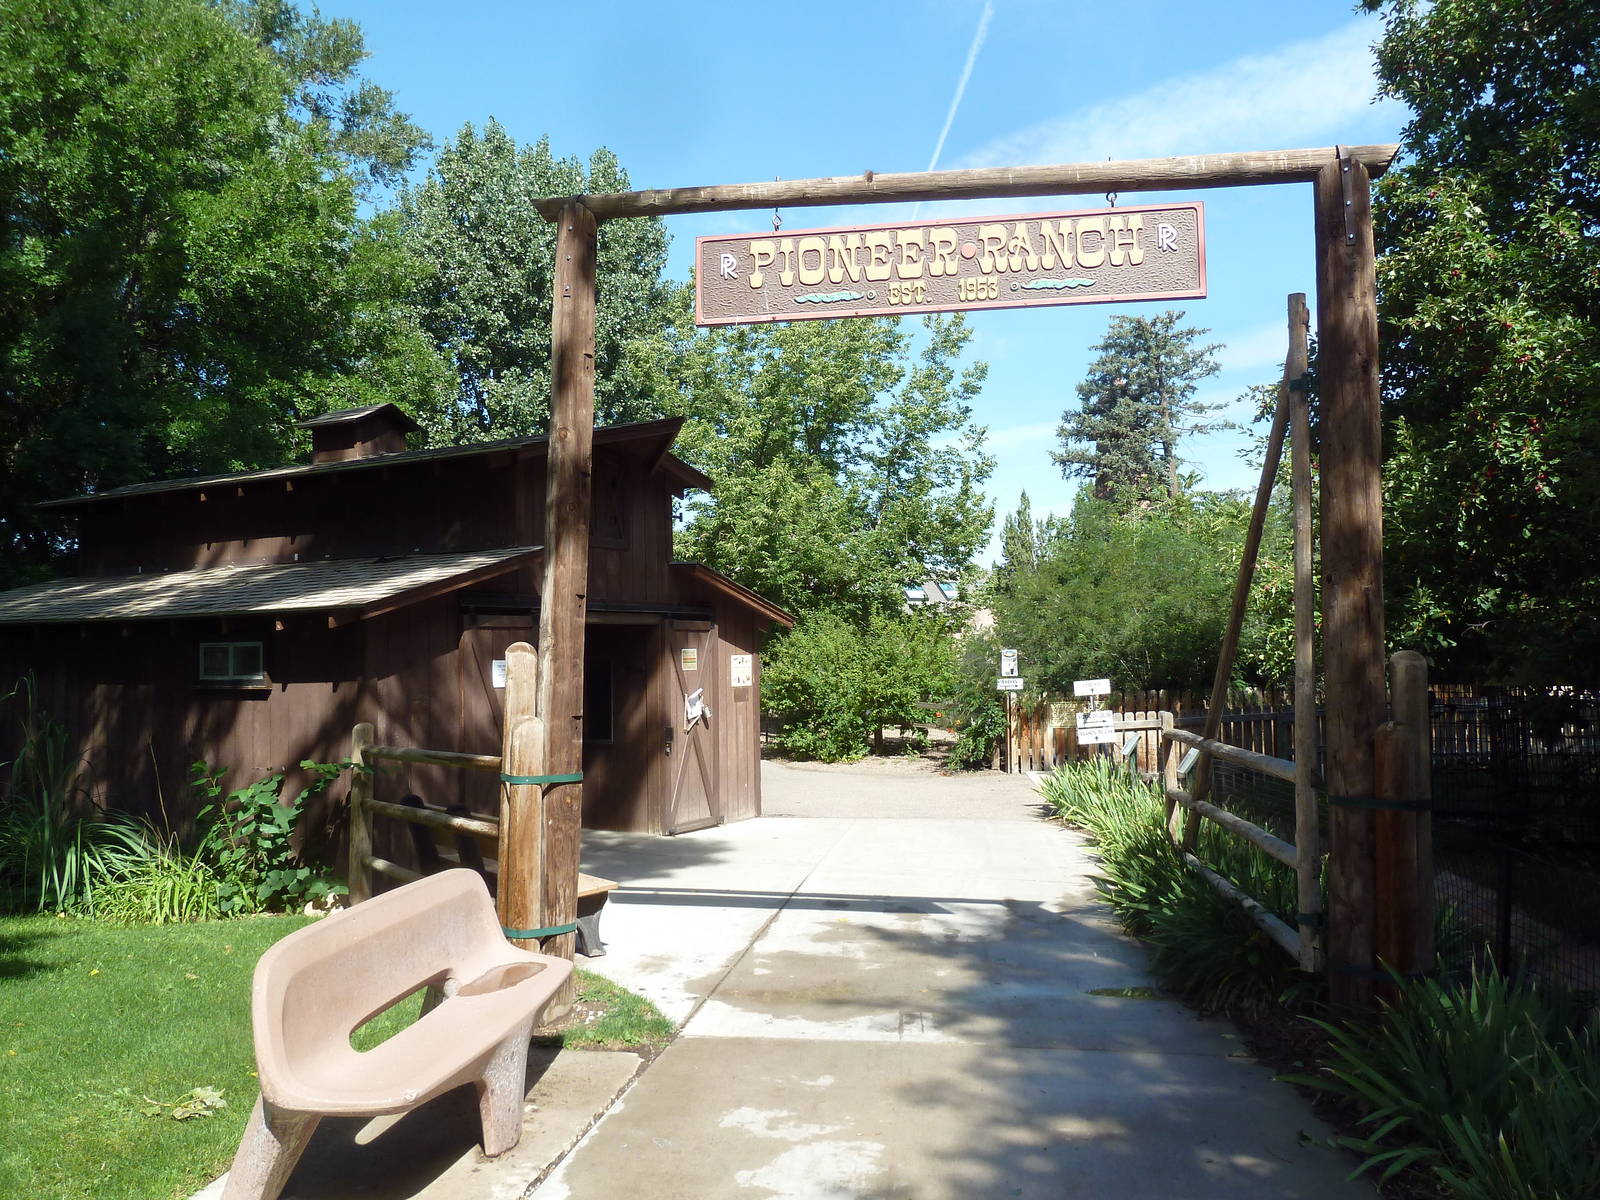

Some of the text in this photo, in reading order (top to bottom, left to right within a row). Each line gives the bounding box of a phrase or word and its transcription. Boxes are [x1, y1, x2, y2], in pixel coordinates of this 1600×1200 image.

[748, 213, 1145, 290] PIONEER RANCH
[887, 276, 998, 306] EST. 1953
